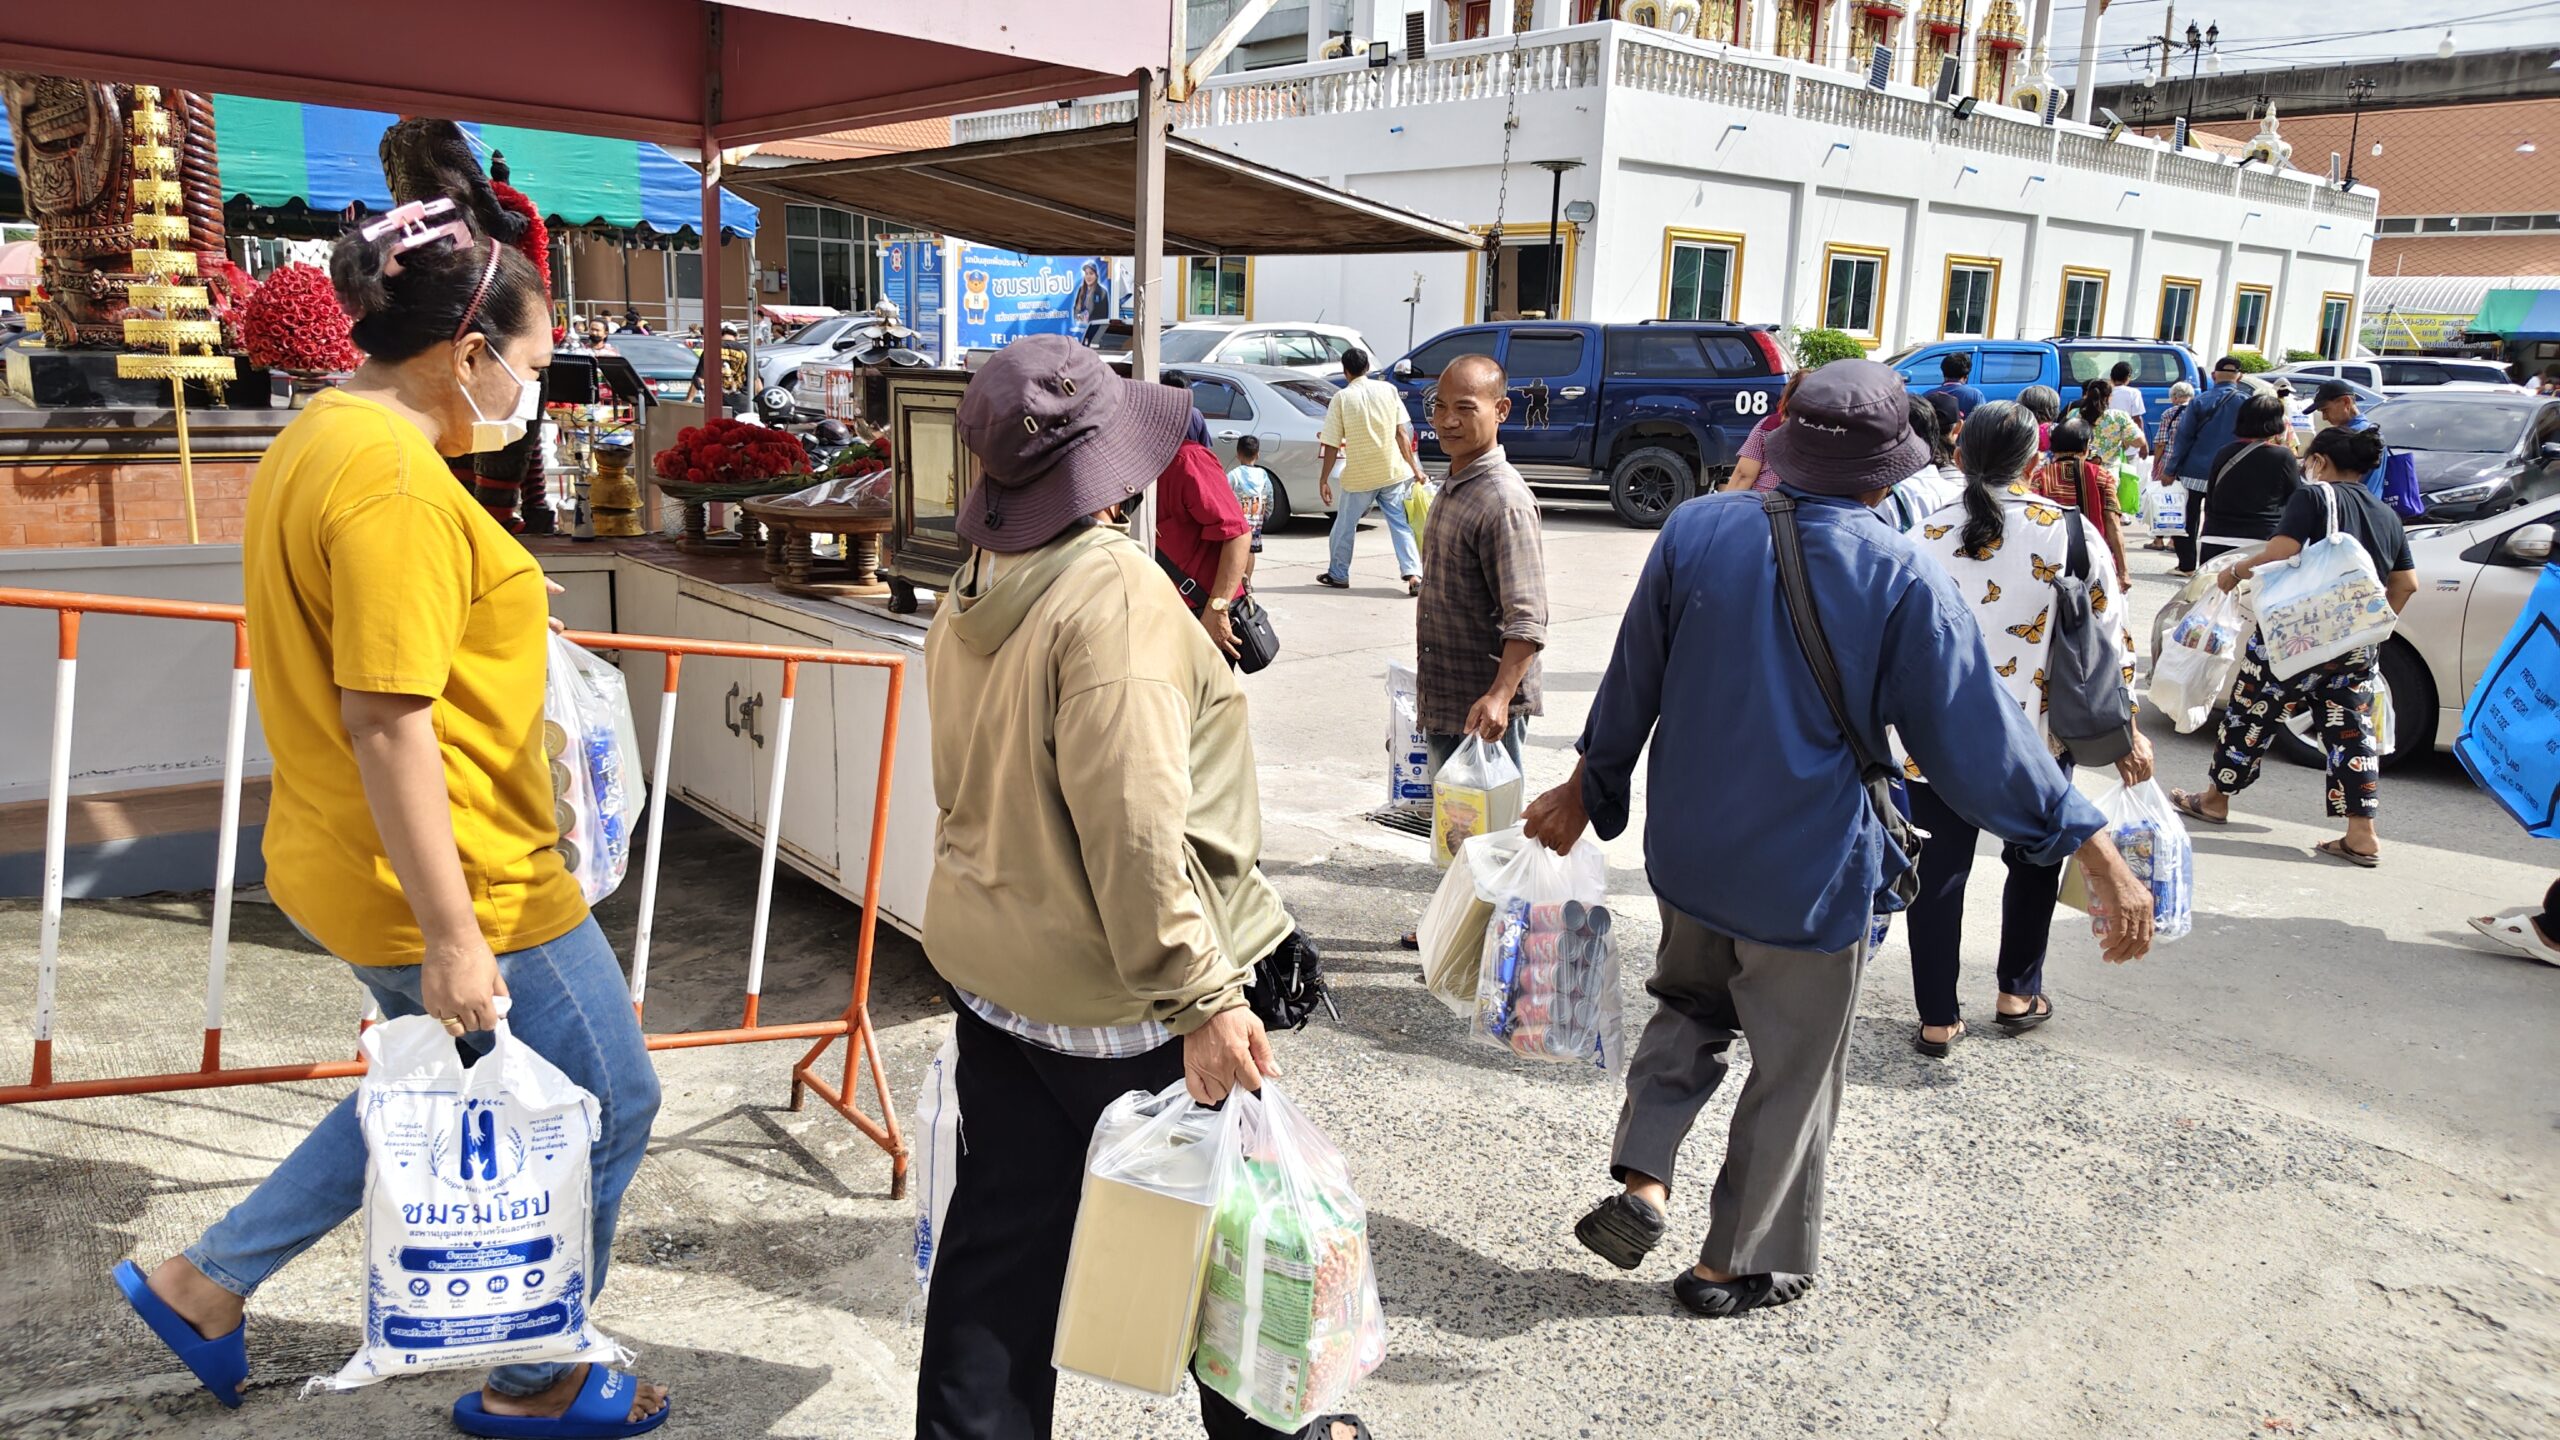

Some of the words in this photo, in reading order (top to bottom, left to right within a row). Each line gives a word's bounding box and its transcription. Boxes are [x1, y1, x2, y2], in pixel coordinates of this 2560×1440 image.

[992, 266, 1074, 297] ชมรมโฮป
[1735, 391, 1768, 415] 08
[2502, 686, 2516, 699] NET
[441, 1175, 463, 1190] Hope
[402, 1190, 550, 1225] ชมรมโฮป
